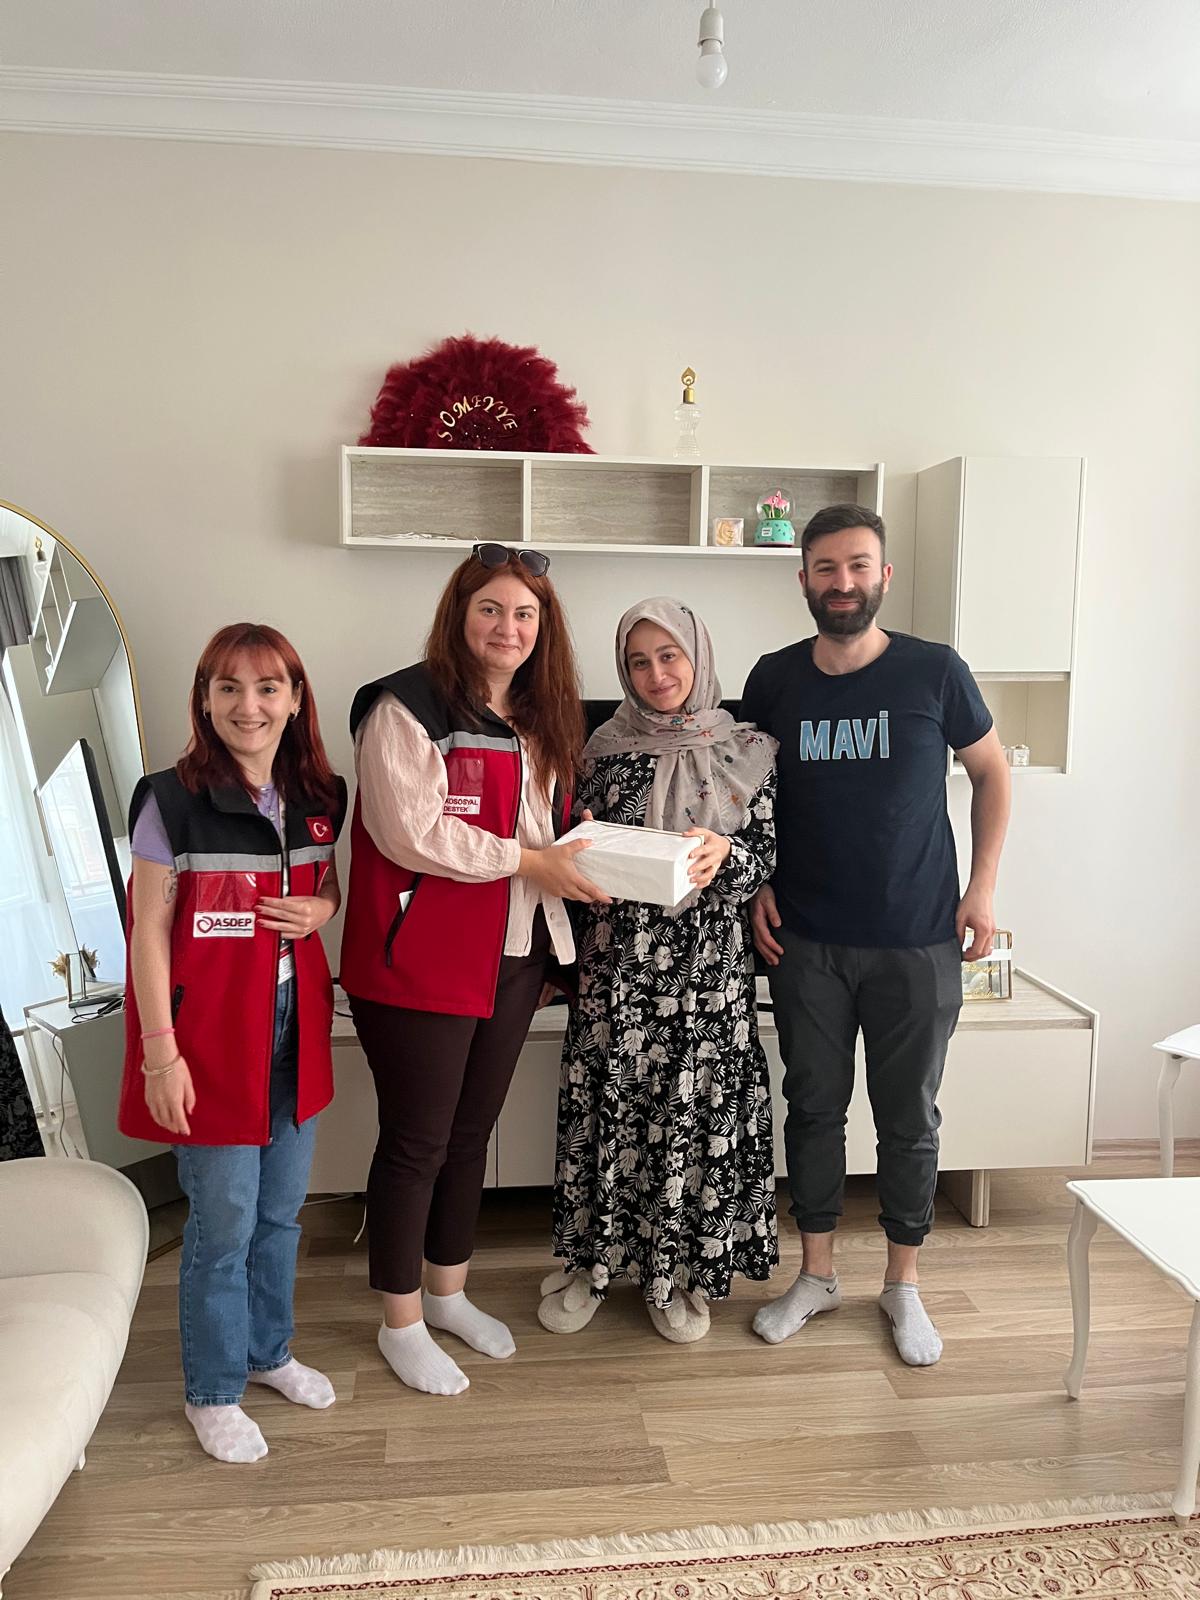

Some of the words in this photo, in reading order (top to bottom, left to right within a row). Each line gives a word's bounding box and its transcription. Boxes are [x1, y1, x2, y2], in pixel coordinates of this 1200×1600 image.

[800, 710, 890, 761] MAVİ
[443, 805, 469, 813] DESTEK
[213, 917, 252, 928] ASDEP
